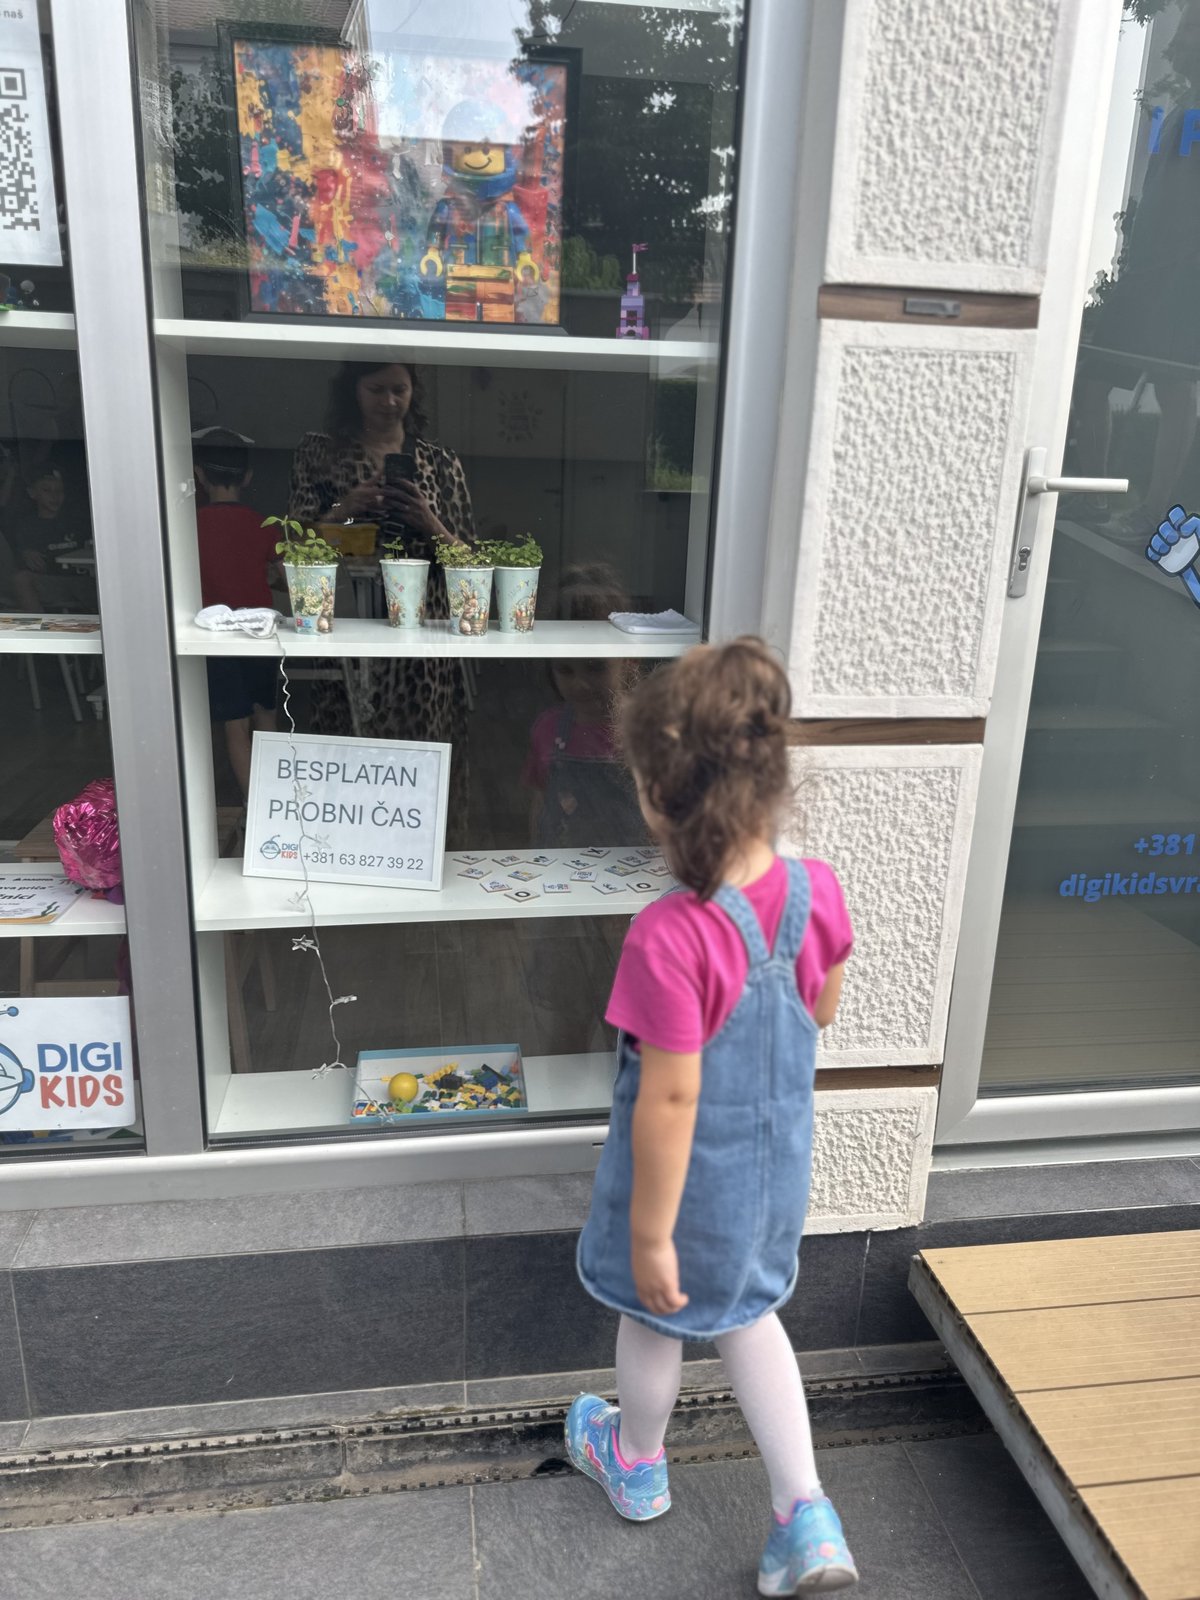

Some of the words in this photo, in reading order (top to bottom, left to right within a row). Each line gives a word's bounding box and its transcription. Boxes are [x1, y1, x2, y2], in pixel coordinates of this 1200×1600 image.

[277, 758, 418, 788] BESPLATAN
[268, 799, 364, 826] PROBNI
[371, 800, 422, 829] ČAS
[281, 843, 299, 851] DIGI
[281, 850, 298, 860] KIDS
[1134, 833, 1196, 856] +381
[303, 851, 335, 864] +381
[339, 853, 356, 866] 63
[359, 854, 384, 868] 827
[387, 856, 404, 869] 39
[406, 857, 424, 871] 22
[37, 1041, 123, 1073] DIGI
[40, 1073, 125, 1110] KIDS
